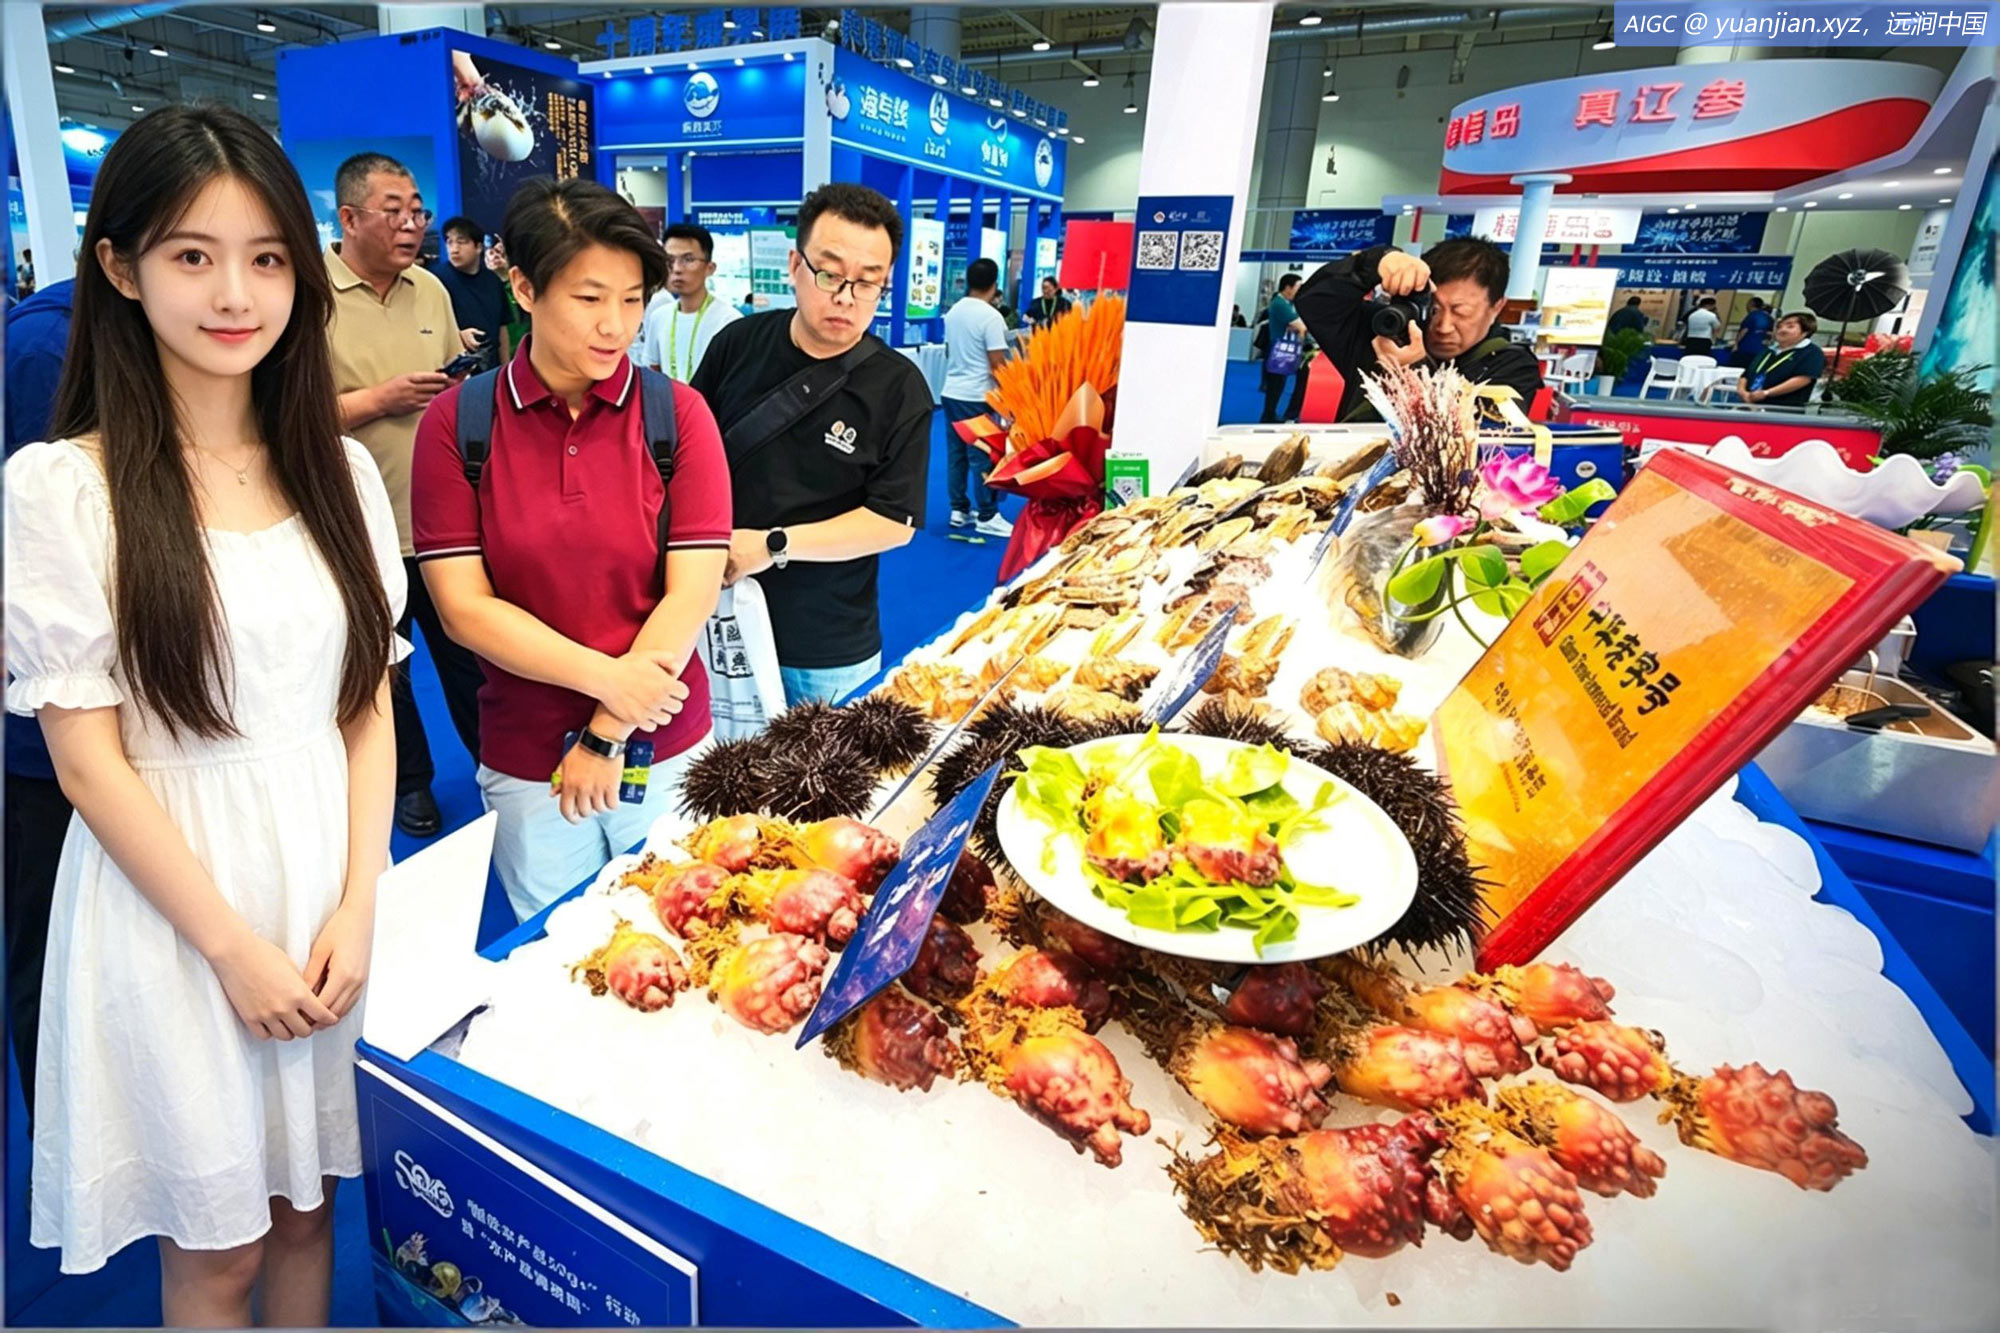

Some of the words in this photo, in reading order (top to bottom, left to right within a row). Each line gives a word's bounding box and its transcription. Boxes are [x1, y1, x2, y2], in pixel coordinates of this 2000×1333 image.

[1574, 79, 1746, 130] 真辽参
[1583, 601, 1682, 715] 中华老字号
